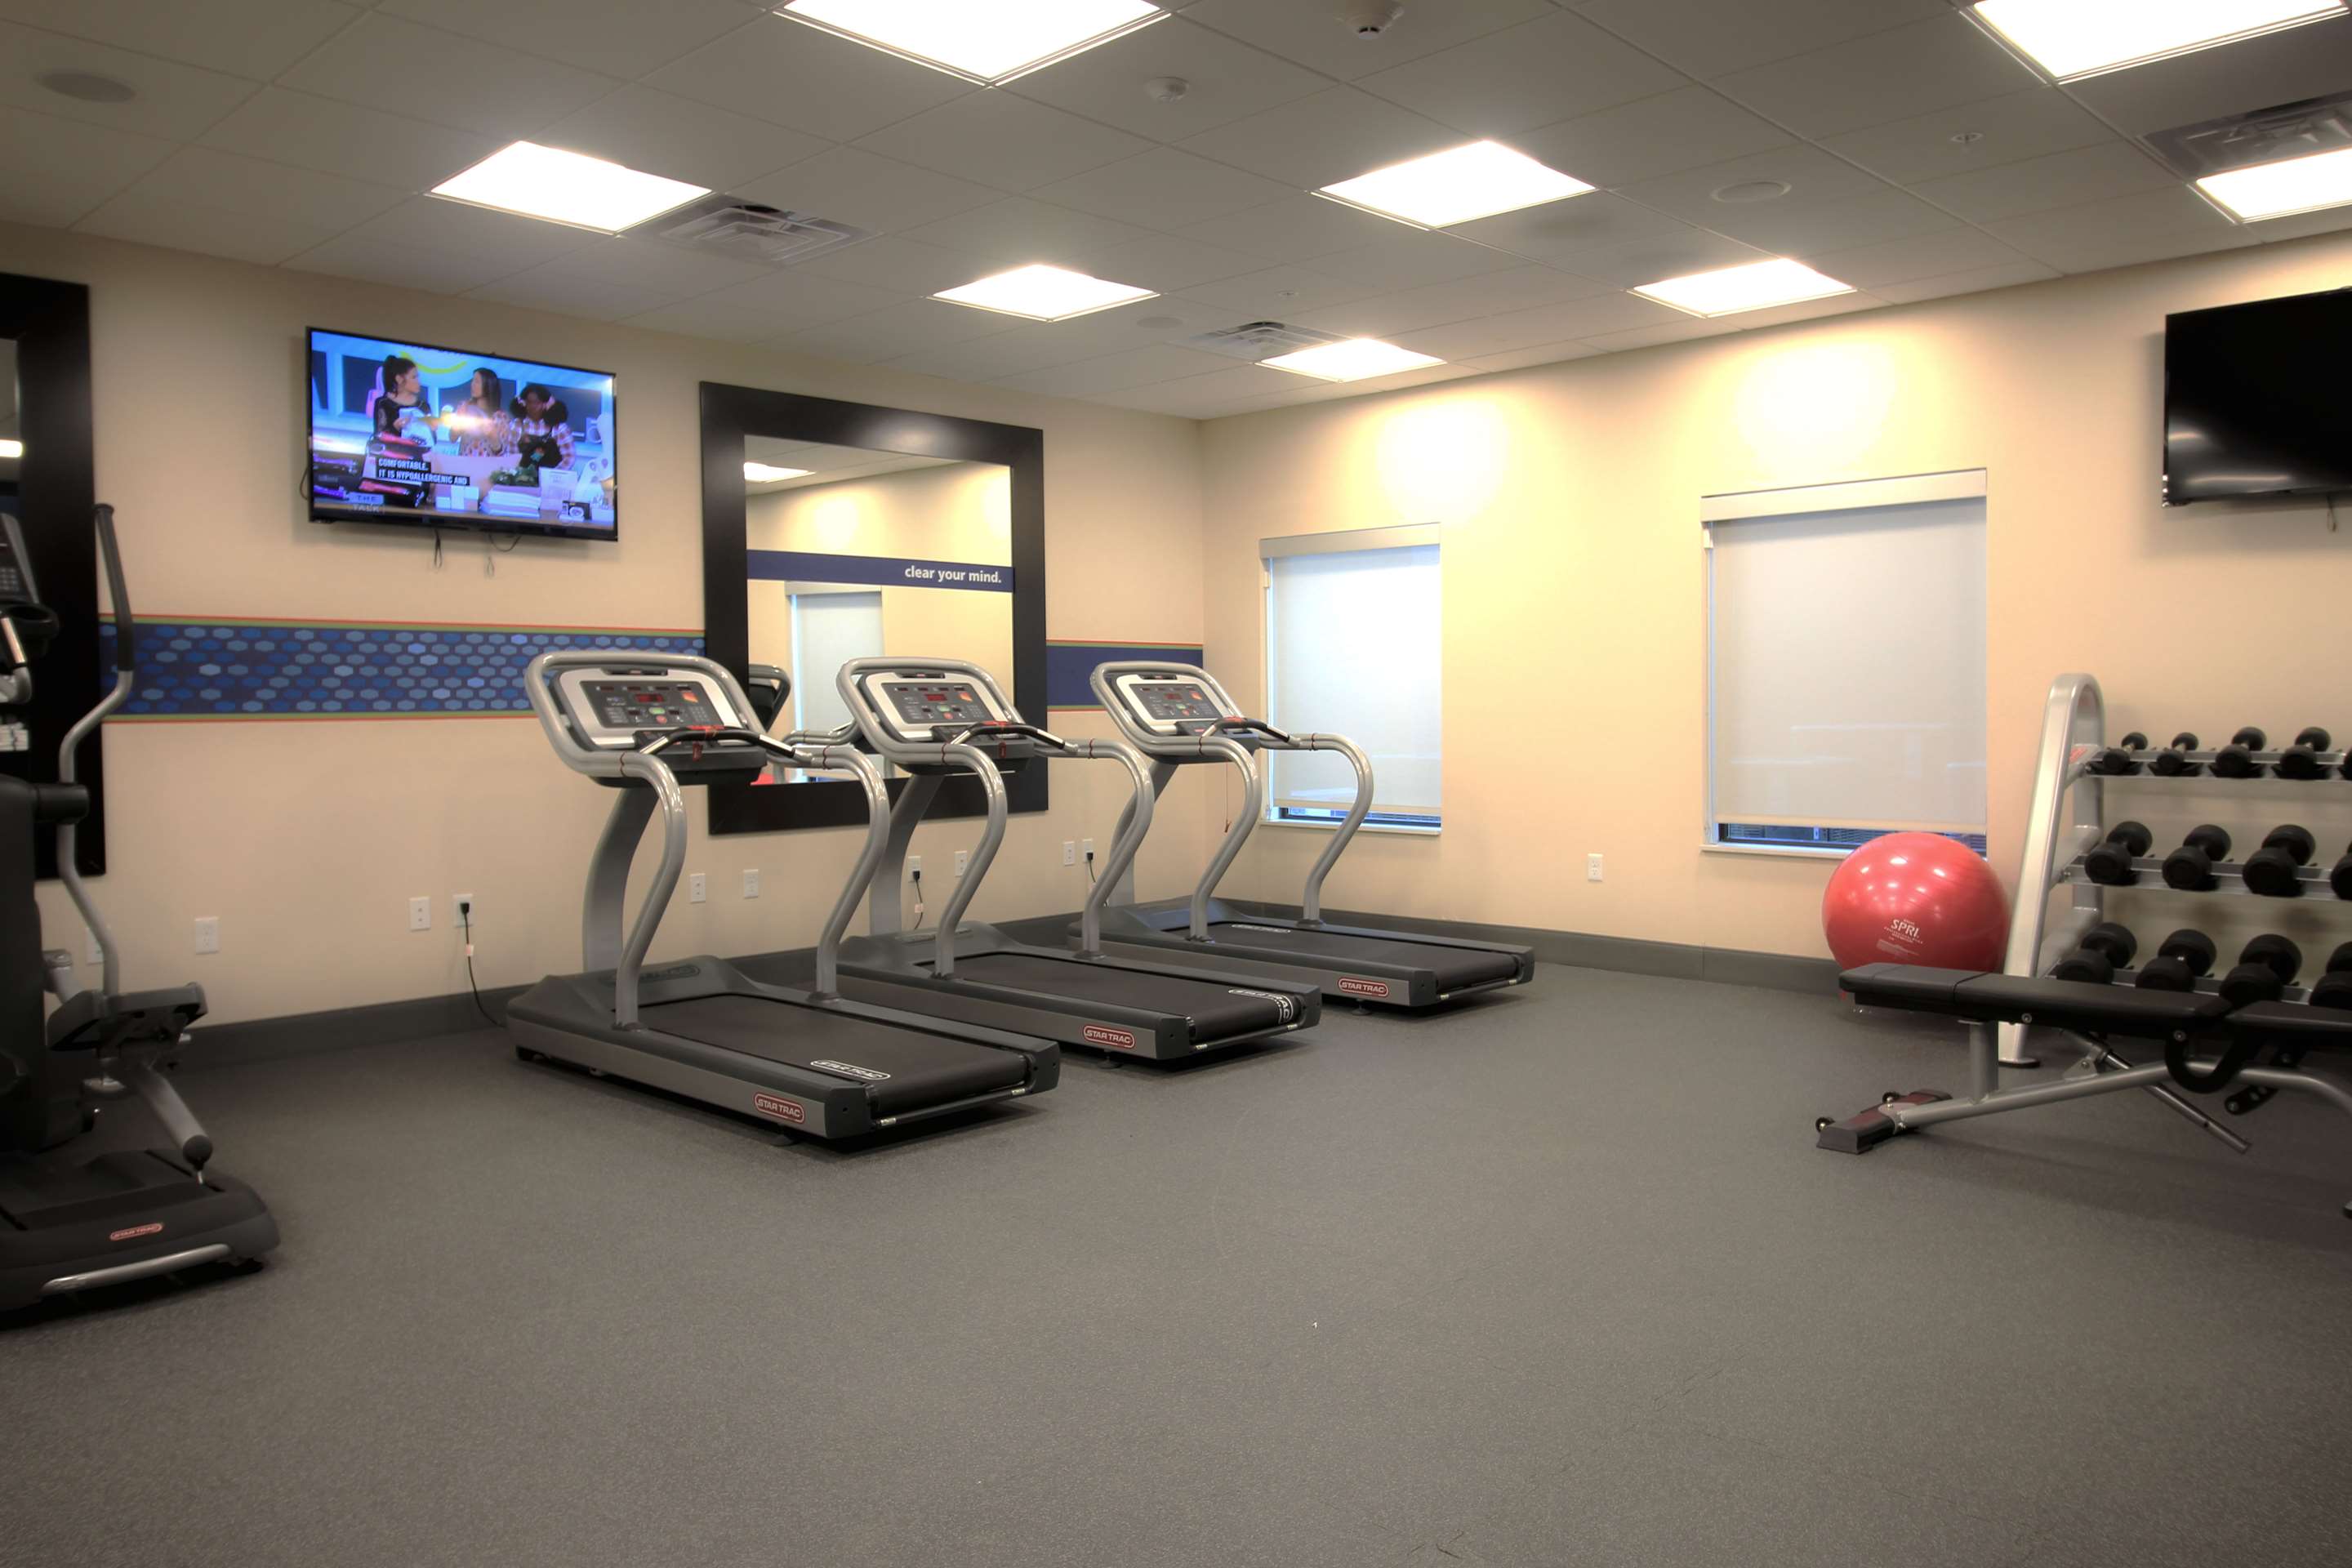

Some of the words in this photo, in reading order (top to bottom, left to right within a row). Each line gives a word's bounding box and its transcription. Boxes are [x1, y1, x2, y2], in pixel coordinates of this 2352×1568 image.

[378, 457, 430, 471] COMFORTABLE.
[378, 468, 386, 479] IT
[387, 469, 395, 479] IS
[396, 470, 453, 484] HYPOALLERGENIC
[453, 476, 468, 485] AND
[357, 494, 380, 502] THE
[904, 564, 936, 579] clear
[938, 570, 966, 583] your
[968, 570, 1002, 584] mind.
[1891, 919, 1920, 938] SPRI
[1341, 982, 1362, 990] STAR
[1362, 984, 1385, 993] TRAC
[1086, 1030, 1107, 1040] STAR
[1108, 1033, 1132, 1044] TRAC
[758, 1098, 777, 1111] STAR
[778, 1104, 801, 1118] TRAC
